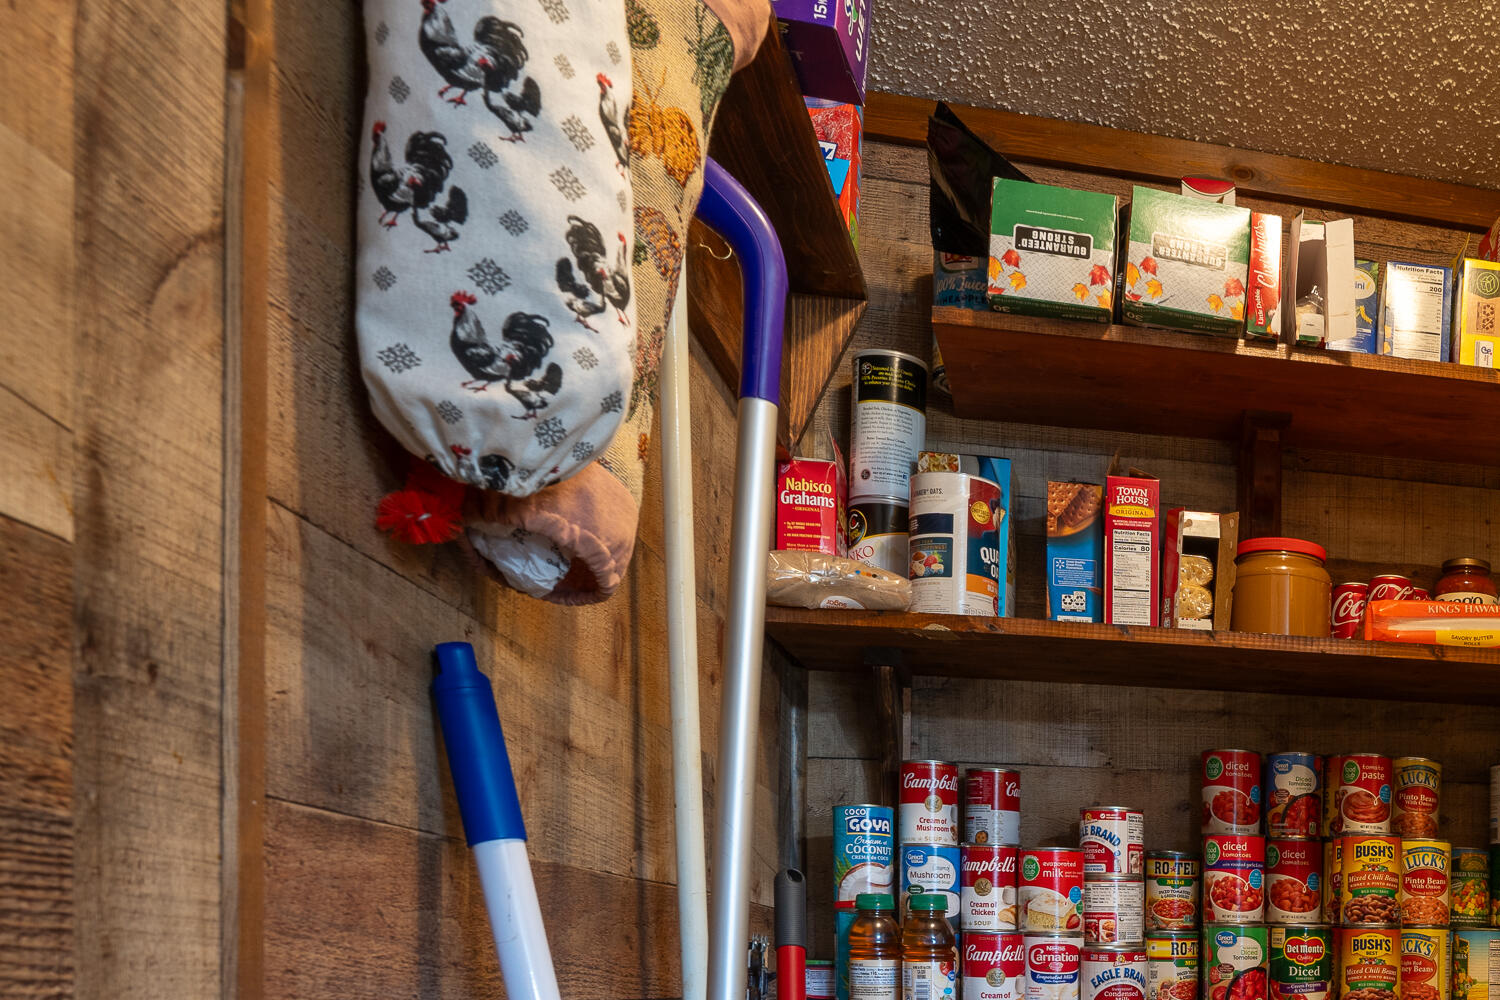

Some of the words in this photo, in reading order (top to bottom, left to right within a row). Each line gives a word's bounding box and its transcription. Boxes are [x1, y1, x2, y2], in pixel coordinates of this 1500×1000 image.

[1031, 230, 1075, 244] STRONG
[1019, 238, 1087, 256] GUARANTEED
[1426, 267, 1443, 275] Facts
[785, 478, 832, 495] Nabisco
[1116, 486, 1148, 497] TOWN
[780, 490, 835, 508] Grahams
[1116, 495, 1149, 506] HOUSE
[1116, 508, 1149, 516] ORIGINAL
[1114, 531, 1136, 540] Nutrition
[1114, 546, 1138, 554] Calories
[1140, 547, 1151, 557] 80
[1451, 634, 1476, 642] SAVORY
[1477, 634, 1494, 642] BUTTER
[1226, 762, 1249, 771] diced
[1226, 770, 1252, 778] tomatoes
[1362, 771, 1385, 781] paste
[1400, 770, 1440, 790] LUCK'S
[844, 808, 866, 816] COCO
[848, 818, 893, 833] GOYA
[854, 836, 882, 846] Cream
[1090, 826, 1121, 847] BRAND
[845, 844, 893, 856] COCONUT
[1222, 842, 1248, 851] diced
[1222, 851, 1252, 859] tomatoes
[1282, 850, 1306, 859] diced
[1356, 845, 1394, 859] BUSH'S
[1405, 854, 1446, 870] LUCK'S
[910, 870, 951, 879] Mushroom
[1042, 870, 1064, 878] milk
[1367, 872, 1385, 881] Chili
[1404, 877, 1426, 886] Pinto
[970, 901, 990, 909] Cream
[1286, 944, 1298, 954] Del
[1300, 944, 1324, 954] Monte
[1352, 938, 1392, 952] BUSH'S
[1030, 948, 1079, 966] Carnation
[1288, 966, 1321, 977] Diced
[1346, 966, 1364, 974] Mixed
[1364, 966, 1380, 974] Chili
[1413, 965, 1434, 974] Beans
[1090, 968, 1121, 989] EAGLE
[980, 992, 1002, 1000] Cream
[1004, 992, 1011, 1000] of
[1104, 990, 1139, 998] Condensed
